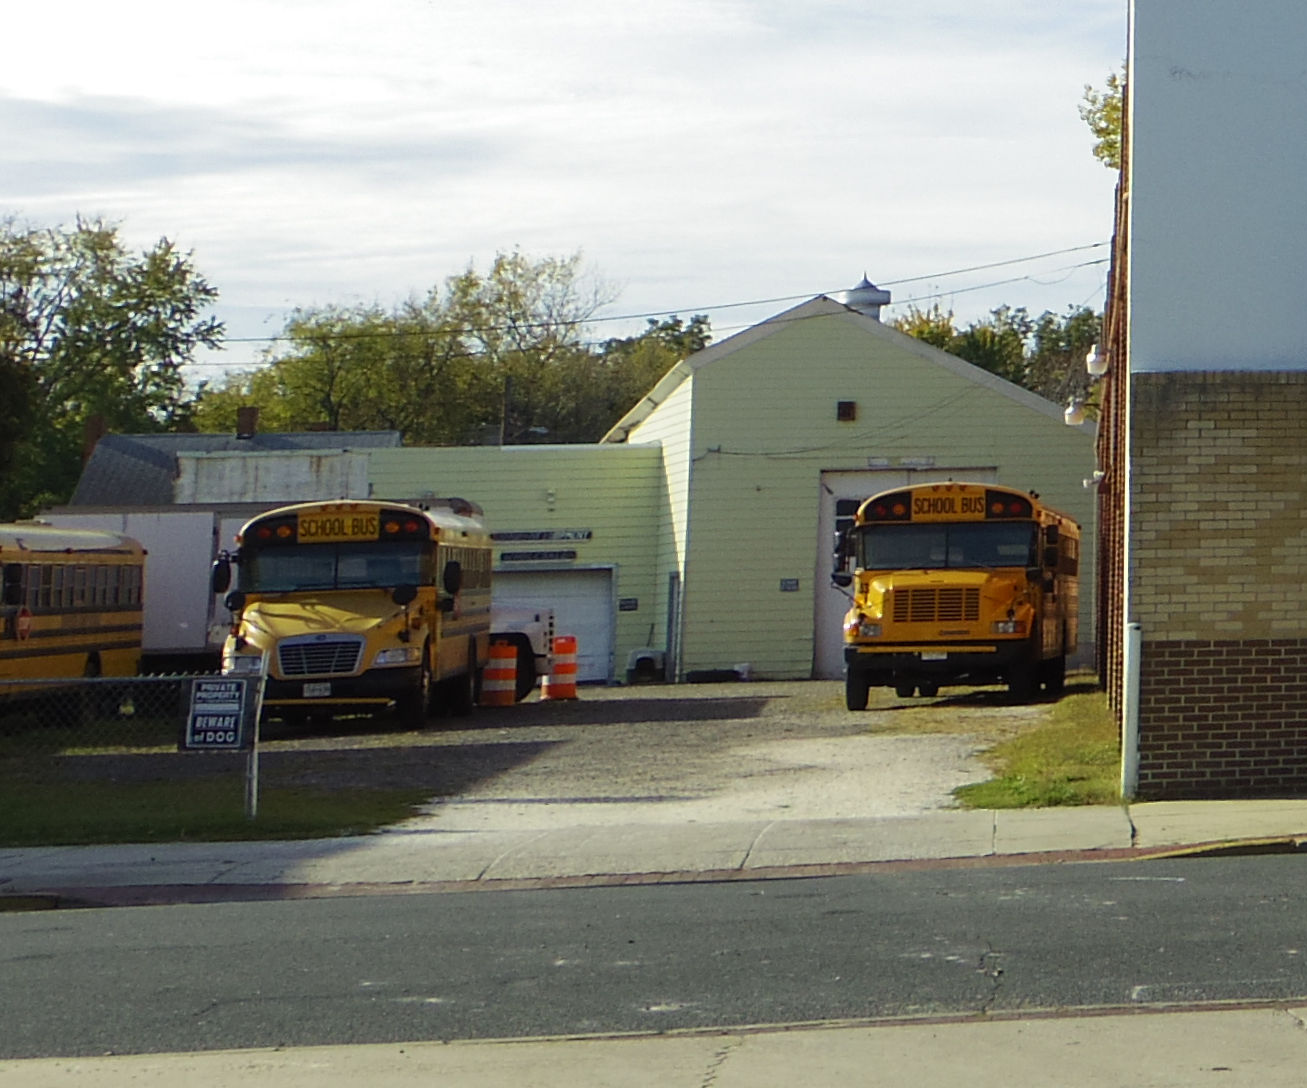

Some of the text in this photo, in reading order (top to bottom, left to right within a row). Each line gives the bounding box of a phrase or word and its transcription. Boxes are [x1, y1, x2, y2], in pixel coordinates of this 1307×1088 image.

[914, 496, 985, 515] SCHOOL BUS
[300, 516, 378, 537] SCHOOL BUS
[195, 716, 235, 729] BEWARE
[206, 731, 235, 743] DOG
